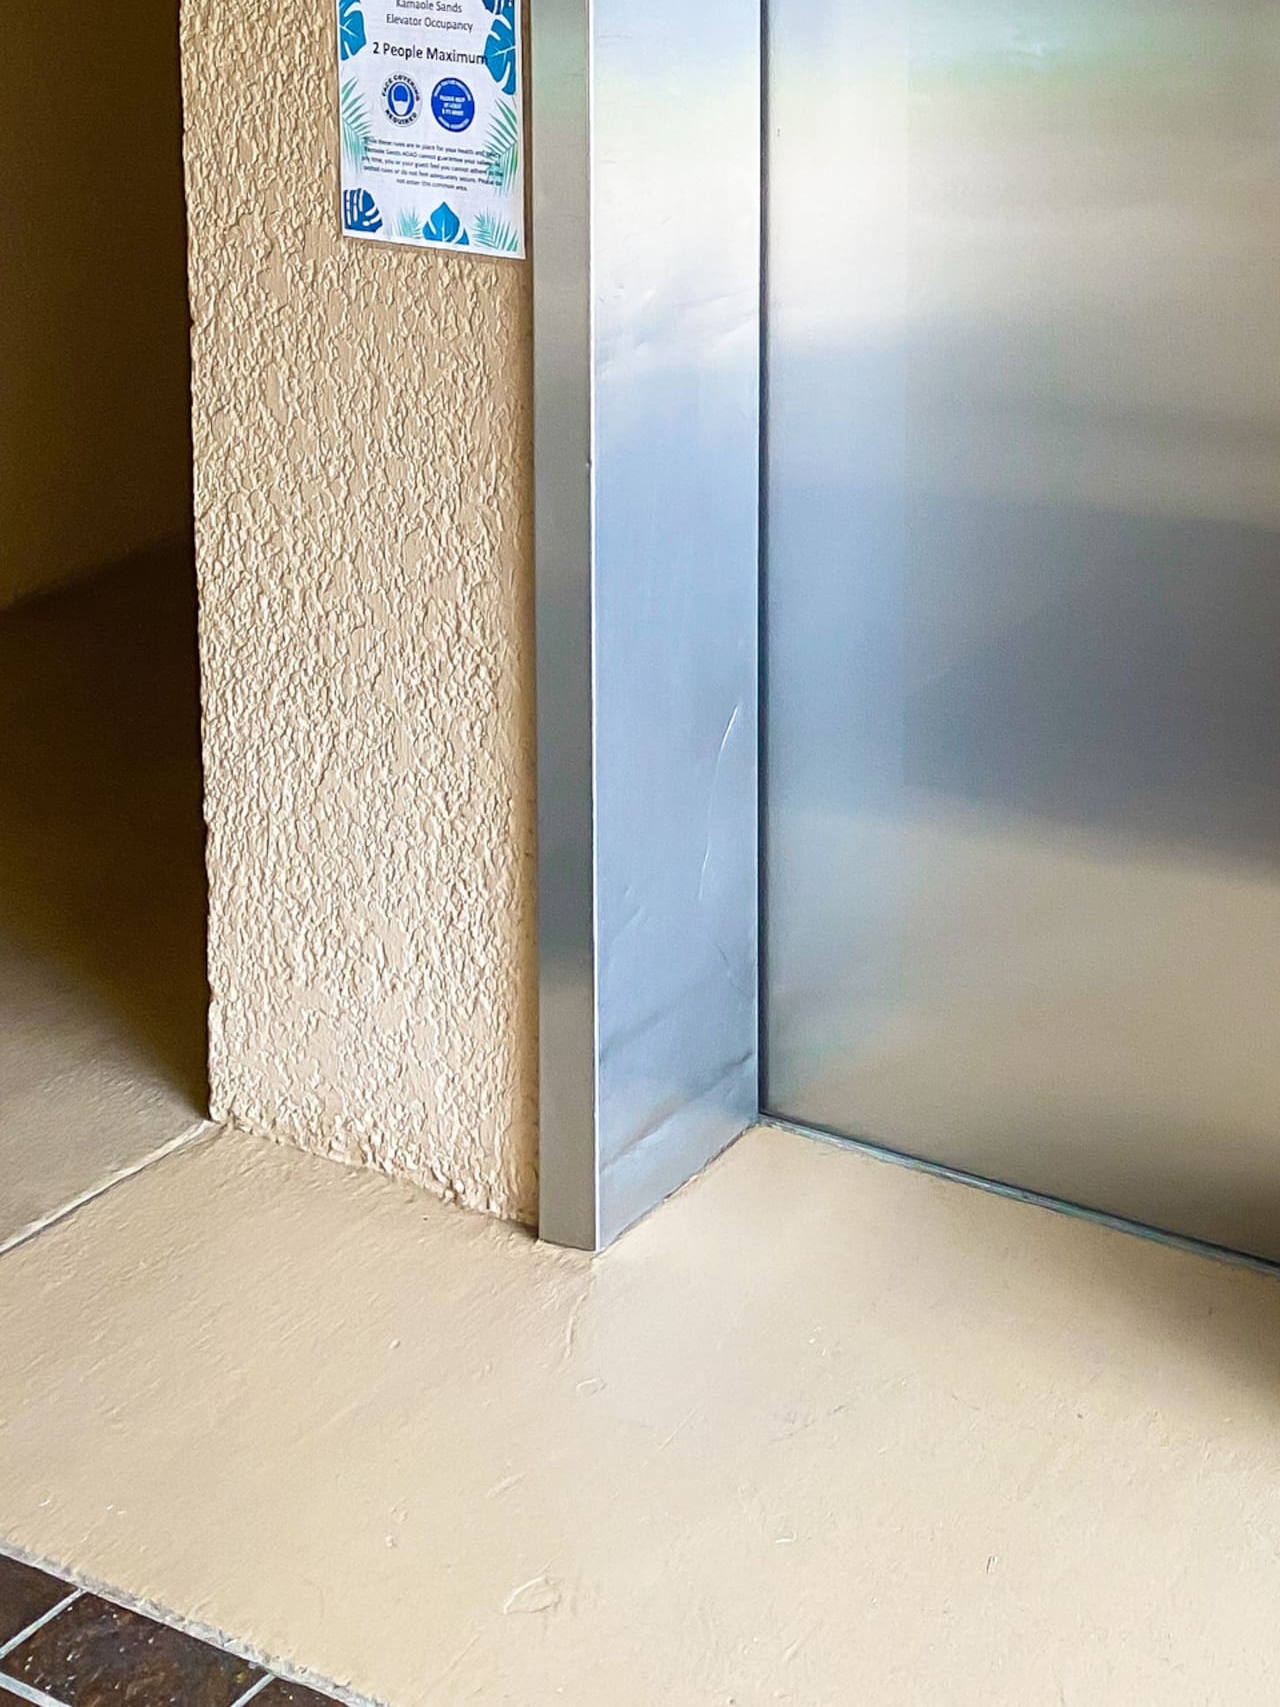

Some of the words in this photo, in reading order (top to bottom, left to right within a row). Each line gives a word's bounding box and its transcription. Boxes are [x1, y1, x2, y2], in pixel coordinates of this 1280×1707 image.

[436, 2, 463, 13] Sands
[386, 14, 422, 26] Elevator
[424, 17, 473, 33] Occupancy
[373, 42, 379, 54] 2
[383, 43, 423, 60] People
[427, 47, 487, 65] Maximum
[382, 78, 394, 96] FACE
[385, 110, 417, 124] REQUIRED
